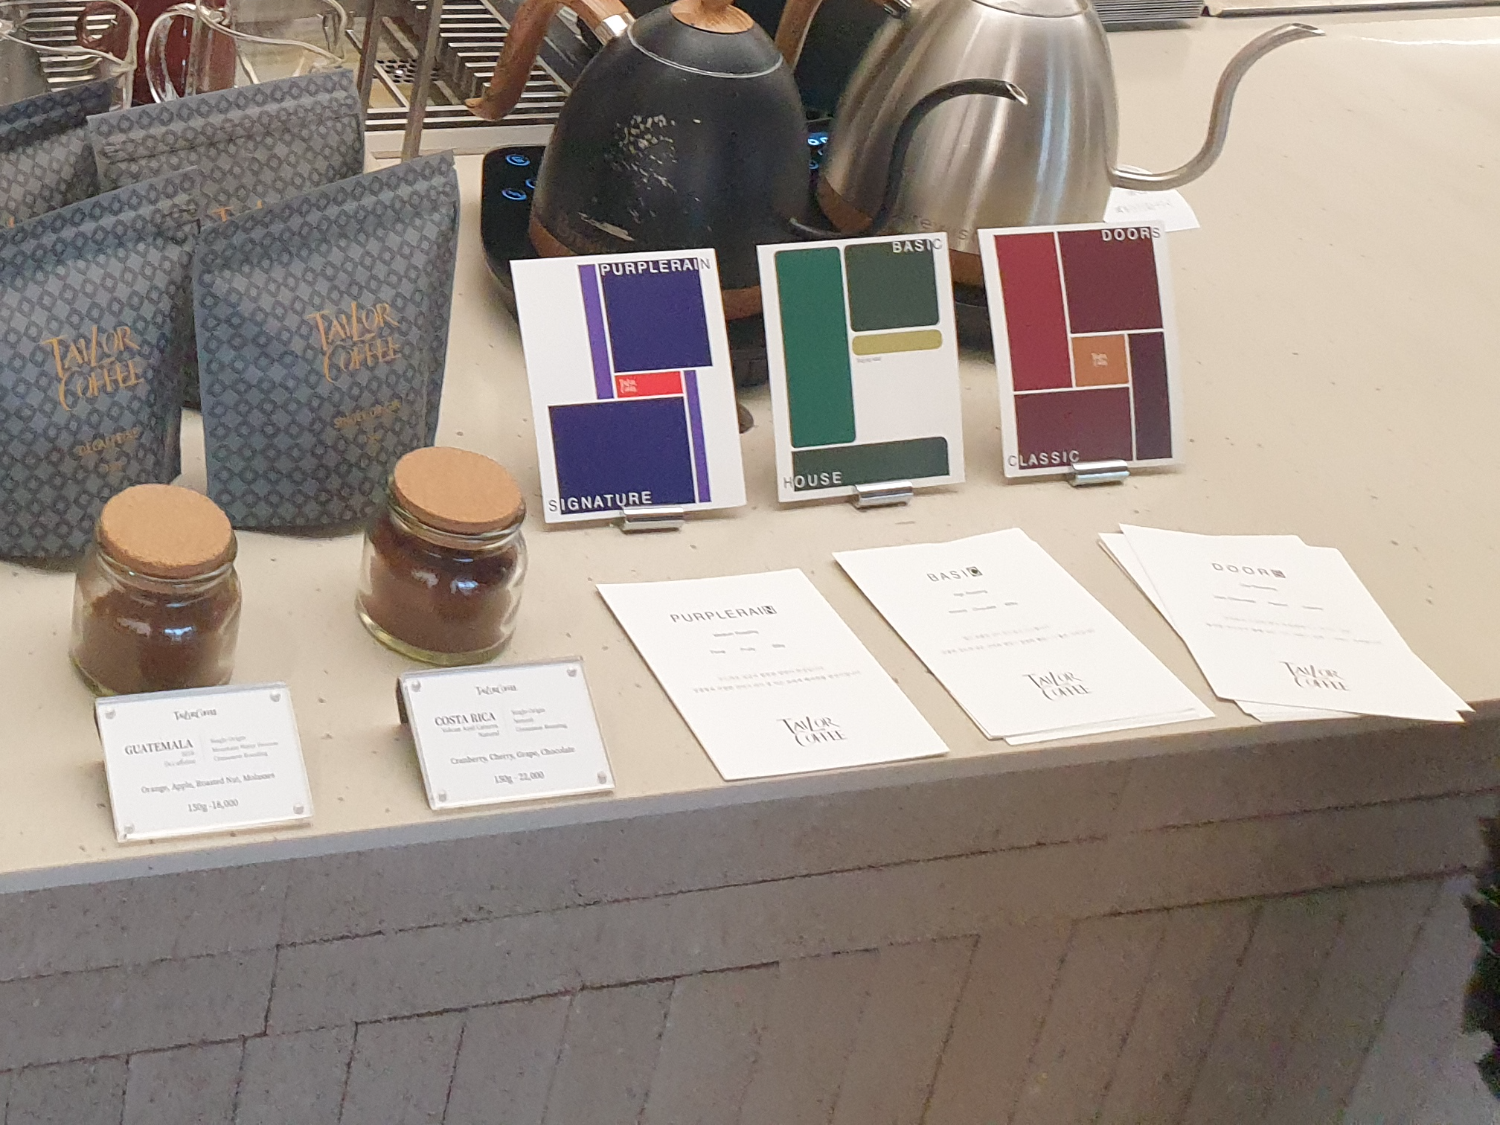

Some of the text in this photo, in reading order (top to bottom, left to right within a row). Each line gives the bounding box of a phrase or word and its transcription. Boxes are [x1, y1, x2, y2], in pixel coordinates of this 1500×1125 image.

[1102, 227, 1161, 242] DOORS
[892, 237, 943, 253] BASIC
[600, 258, 711, 276] PURPLERAIN
[1008, 450, 1080, 467] CLASSIC
[784, 471, 842, 489] HOUSE
[548, 491, 652, 512] SIGNATURE
[434, 712, 496, 727] COSTA RICA
[124, 739, 194, 755] GUATEMALA
[541, 746, 576, 755] Chocolate
[141, 785, 170, 794] Orange,
[172, 781, 195, 791] Apple,
[188, 803, 208, 813] 150g
